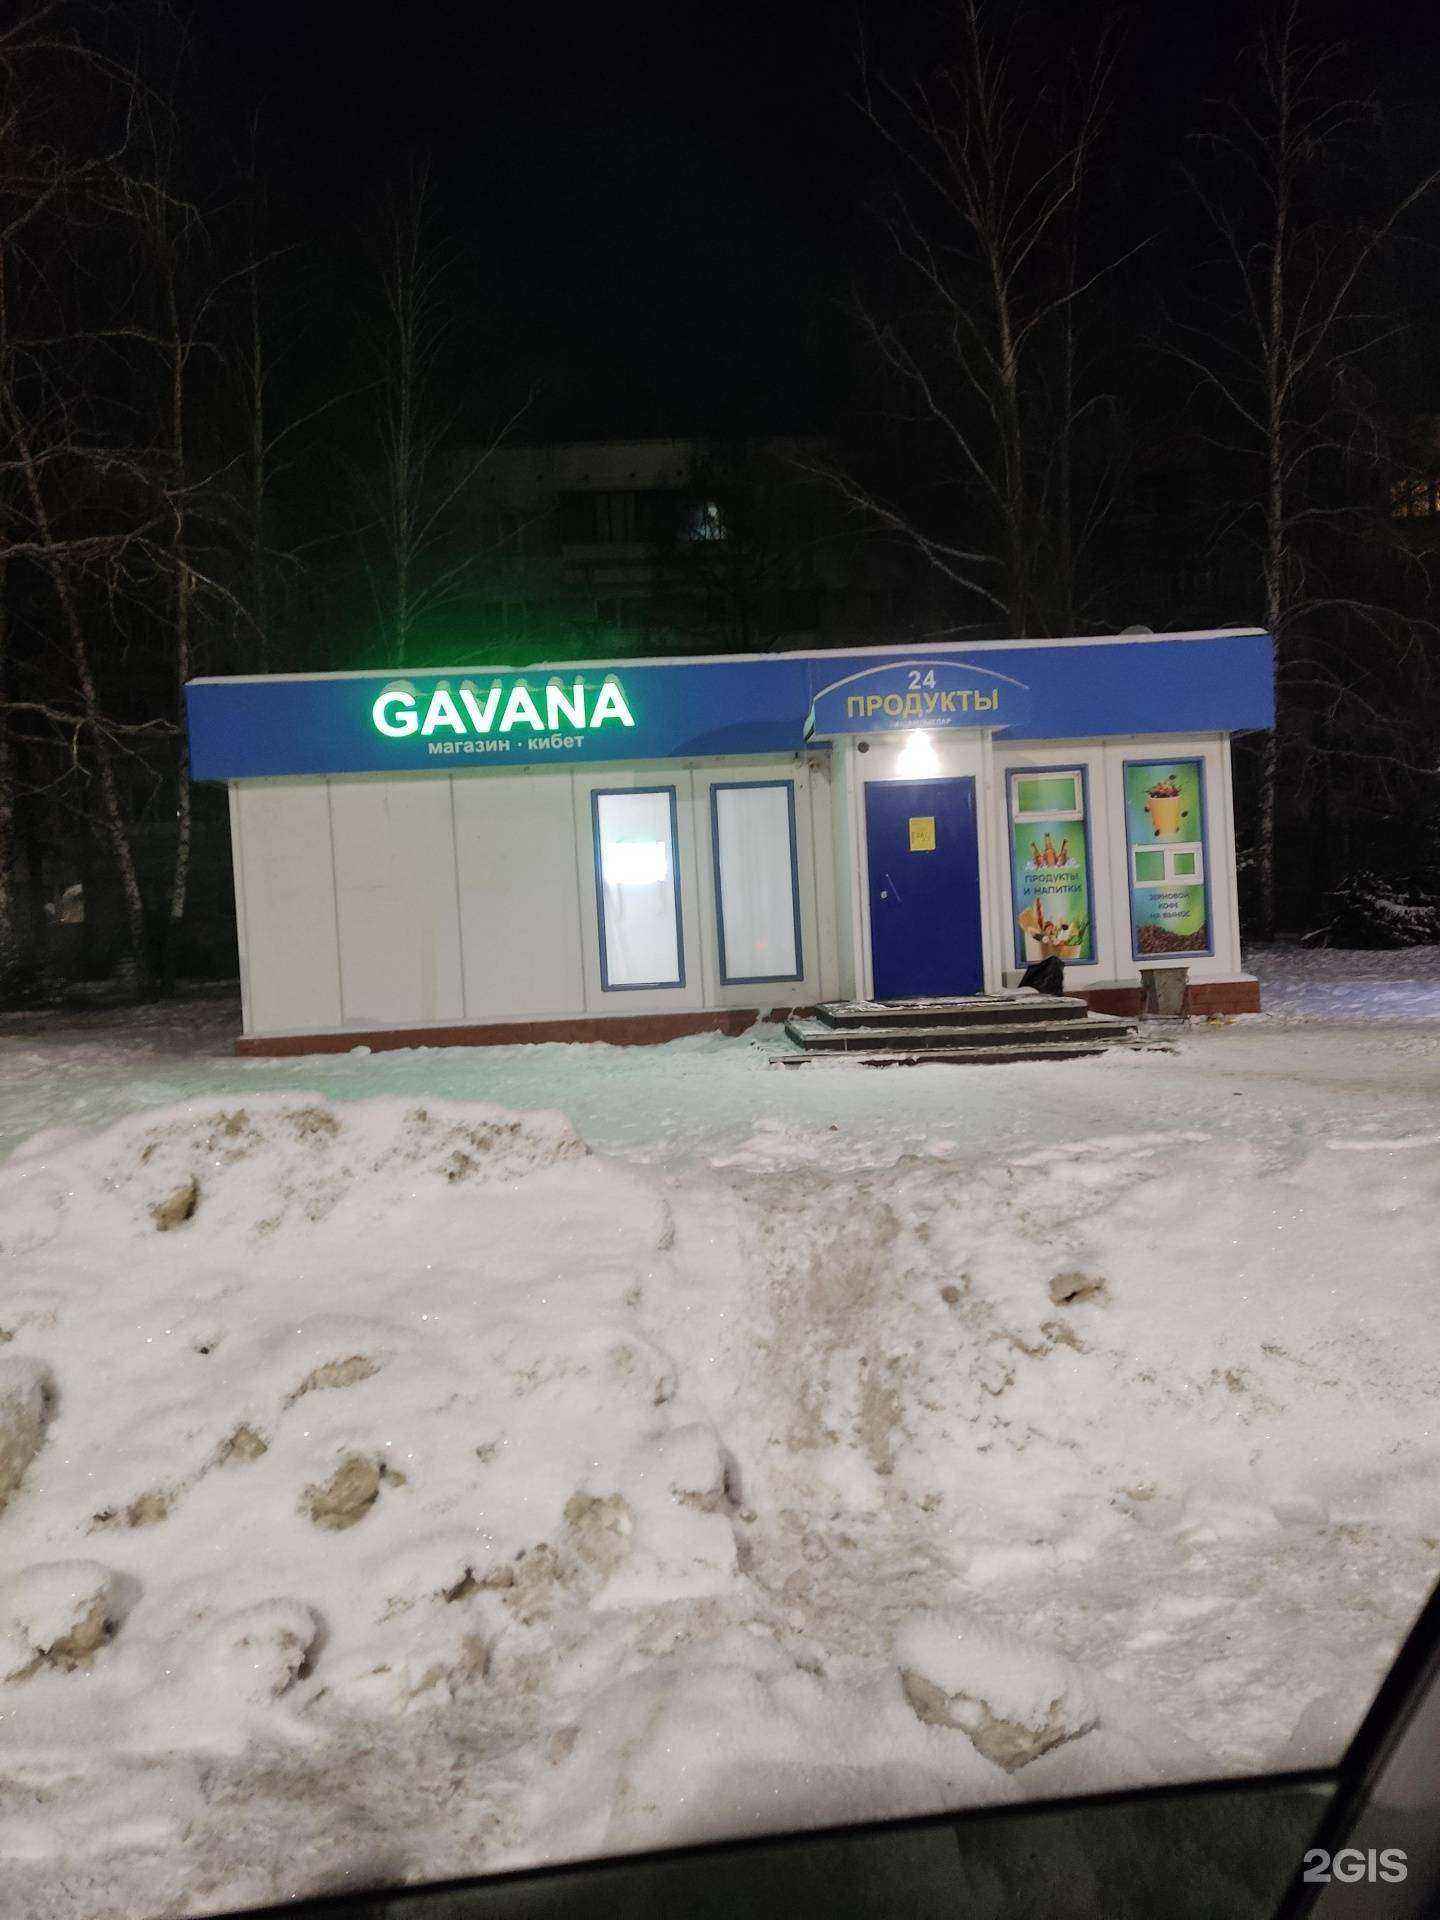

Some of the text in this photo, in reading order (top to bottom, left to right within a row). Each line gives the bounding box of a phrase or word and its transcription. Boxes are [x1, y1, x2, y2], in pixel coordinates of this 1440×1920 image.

[908, 669, 936, 690] 24
[372, 682, 635, 738] GAVANA
[847, 688, 999, 718] ПРОДУКТЫ
[428, 733, 585, 755] магазин кибет
[1025, 872, 1079, 884] ПРОДУКТЫ
[1024, 884, 1082, 896] И НАПИТКИ
